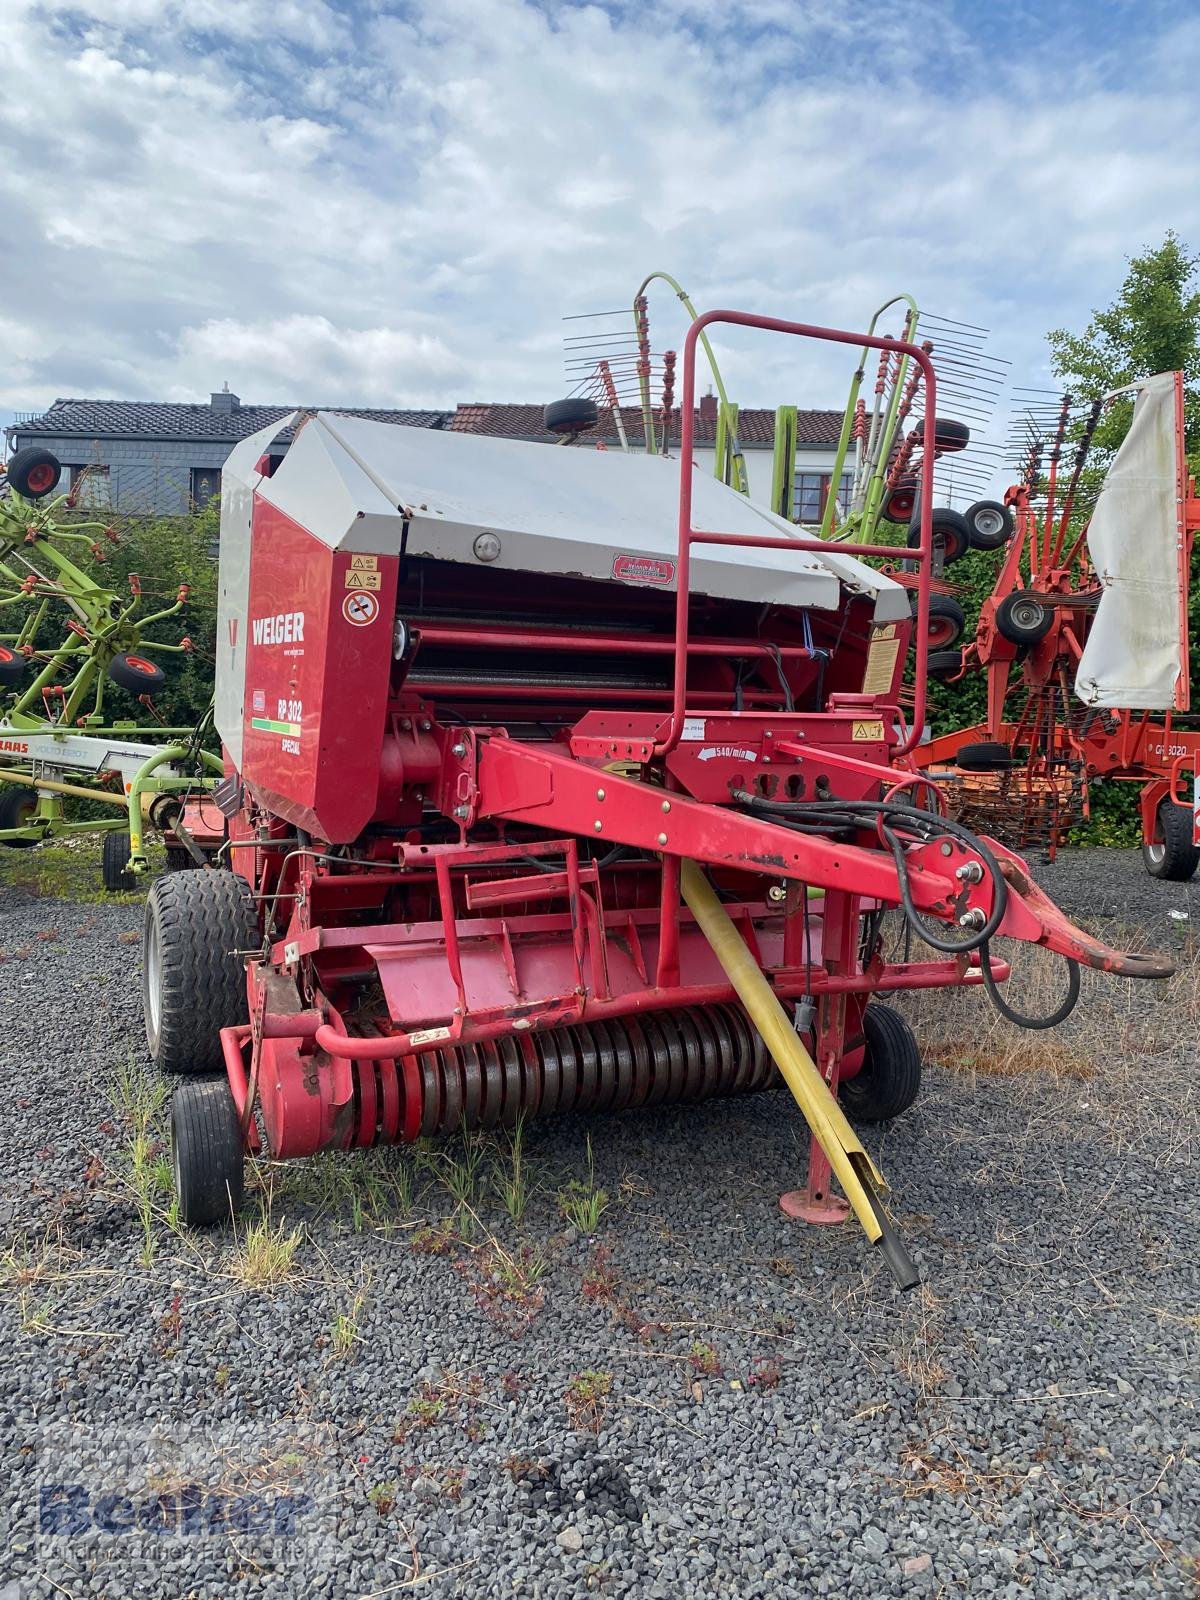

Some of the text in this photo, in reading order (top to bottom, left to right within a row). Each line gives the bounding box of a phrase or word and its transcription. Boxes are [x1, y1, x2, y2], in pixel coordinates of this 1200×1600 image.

[252, 611, 305, 645] WELGER
[278, 699, 287, 720] RP
[287, 699, 303, 722] 302
[281, 738, 301, 756] SPECIAL
[716, 746, 746, 758] 540/min
